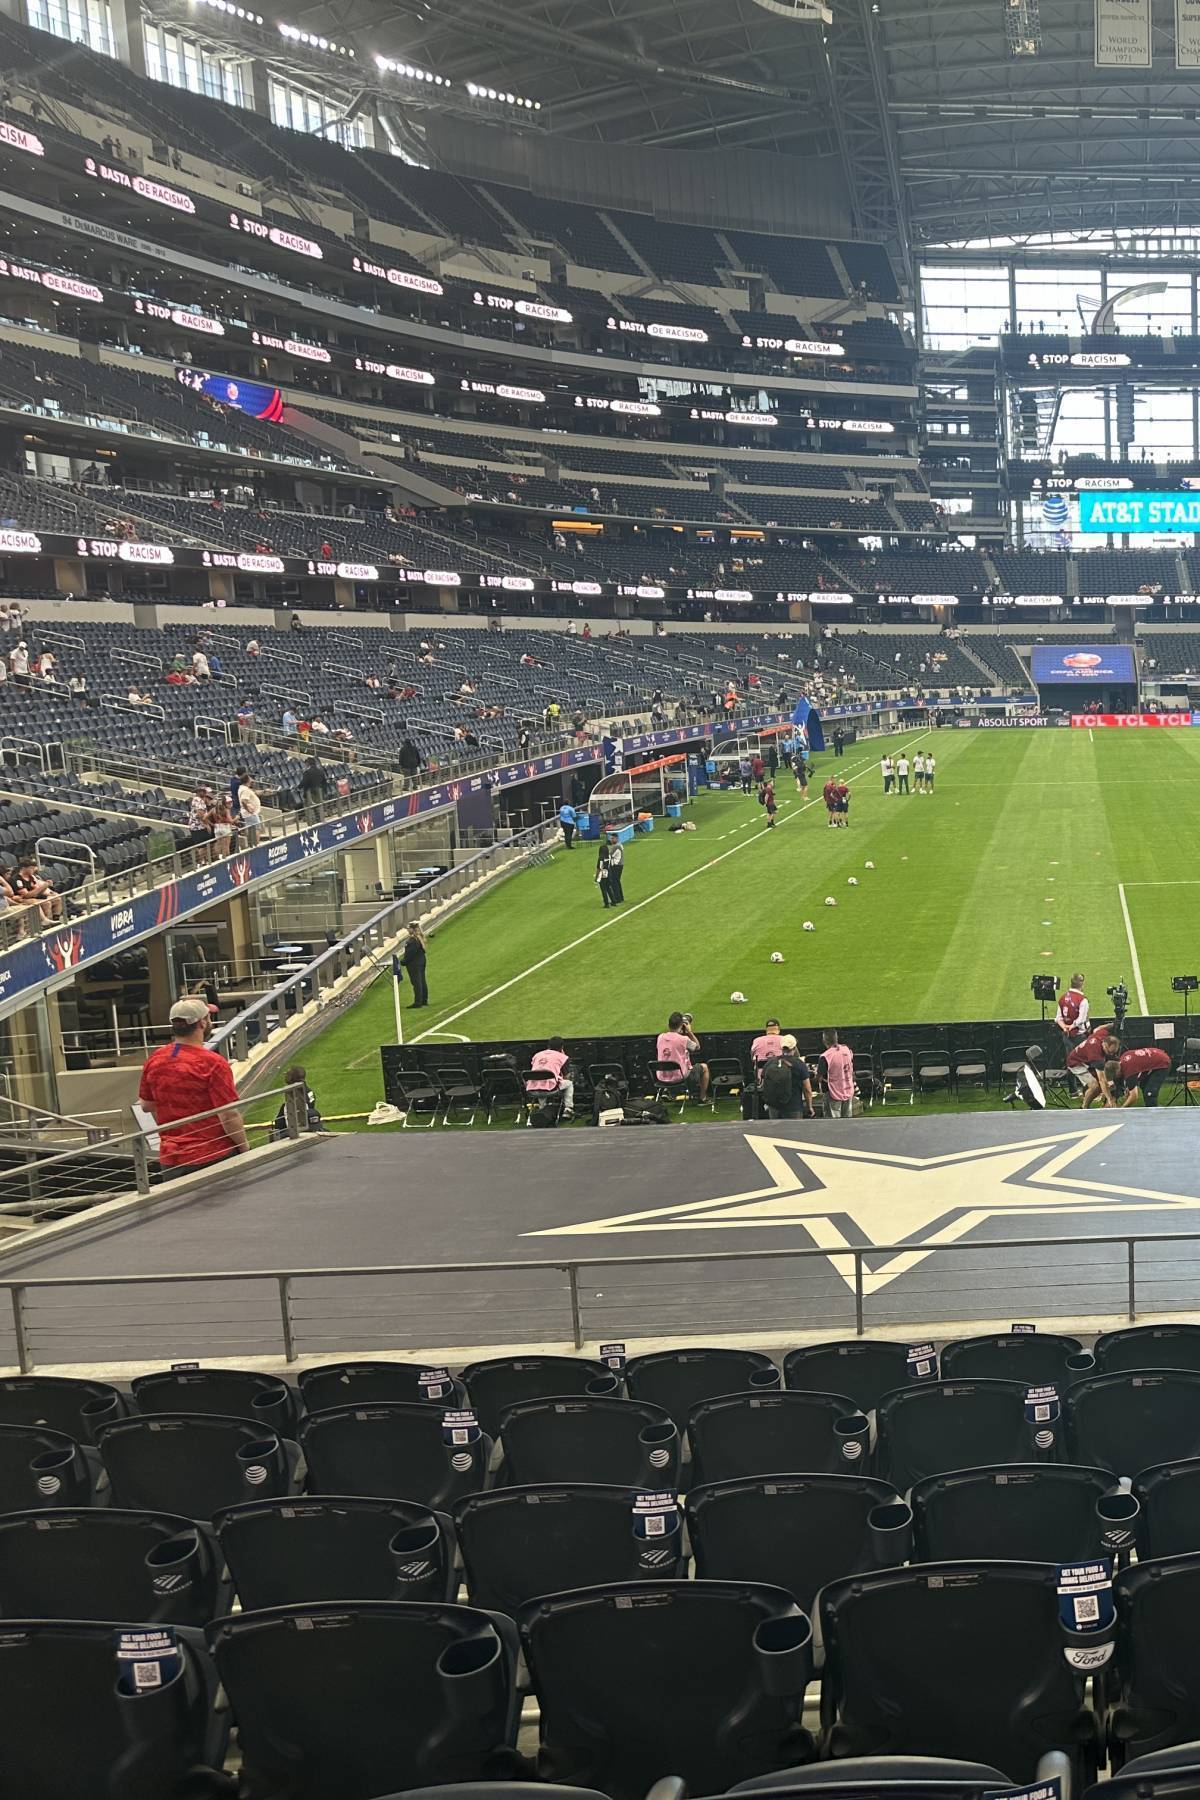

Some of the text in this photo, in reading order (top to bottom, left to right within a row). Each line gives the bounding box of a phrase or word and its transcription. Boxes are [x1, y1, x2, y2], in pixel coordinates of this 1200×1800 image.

[1100, 45, 1146, 54] CHAMPIONS
[99, 165, 191, 210] BASTA DE RACISMO
[116, 232, 138, 249] WARE
[242, 219, 311, 253] STOP RACISM
[10, 263, 99, 298] BASTA DE RACISMO
[362, 262, 440, 292] BASTA DE RACISMO
[487, 296, 560, 319] STOP RACISM
[147, 306, 213, 331] STOP RACISM
[619, 320, 704, 339] BASTA DE RACISMO
[262, 336, 284, 351] BASTA
[288, 342, 299, 353] DE
[757, 338, 831, 353] STOP RACISM
[1043, 355, 1118, 364] STOP RACISM
[365, 361, 424, 381] STOP RACISM
[472, 382, 543, 400] BASTA DE RACISMO
[587, 398, 649, 413] STOP RACISM
[1047, 478, 1120, 488] STOP RACISM
[1090, 503, 1142, 523] AT&T
[91, 541, 162, 561] STOP RACISM
[978, 717, 1018, 727] ABSOLUT
[1020, 717, 1048, 727] SPORT
[1072, 714, 1106, 726] TCL
[1116, 714, 1147, 726] TCL
[1157, 714, 1191, 726] TCL
[111, 908, 134, 931] VIBRA
[1072, 1568, 1085, 1576] YOUR
[1072, 1649, 1107, 1665] Ford
